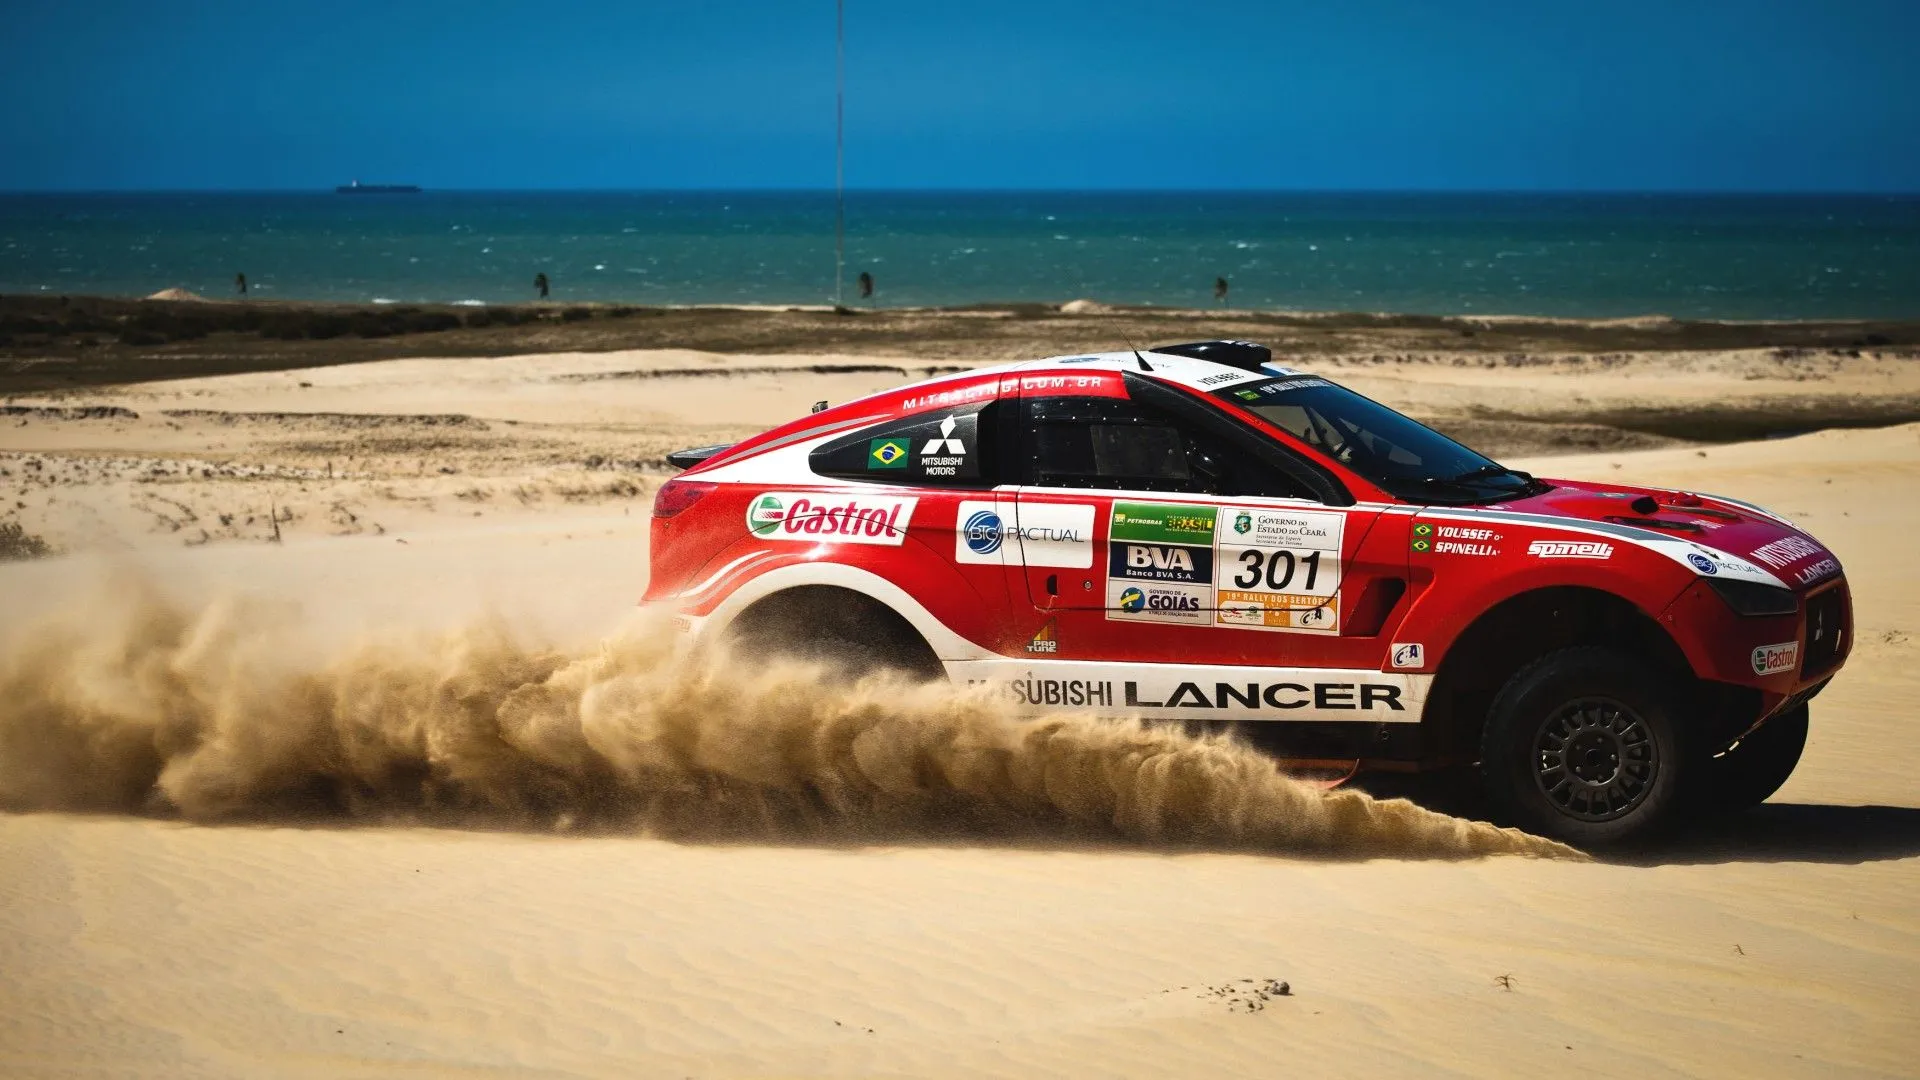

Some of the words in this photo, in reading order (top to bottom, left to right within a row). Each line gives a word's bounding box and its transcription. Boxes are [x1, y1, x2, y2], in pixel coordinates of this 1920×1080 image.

[921, 457, 963, 466] MITSUBISHI
[926, 467, 956, 476] MOTORS
[784, 499, 902, 538] Castrol
[970, 525, 1000, 541] BTG
[1007, 527, 1085, 543] PACTUAL
[1436, 526, 1493, 540] YOUSSEF
[1127, 545, 1195, 571] BVA
[1434, 541, 1492, 556] SPINELLI
[1527, 540, 1614, 559] spinelli
[1750, 535, 1822, 570] MITSUBISHI
[1126, 569, 1153, 577] Banco
[1156, 571, 1174, 579] BVA
[1234, 549, 1320, 590] 301
[1795, 559, 1835, 585] LANCER
[1148, 593, 1200, 612] GOIÁS
[1243, 593, 1268, 602] RALLY
[1271, 595, 1288, 603] DOS
[1767, 647, 1796, 669] Castrol
[967, 679, 1115, 706] SUBISHI
[1125, 681, 1406, 711] LANCER
